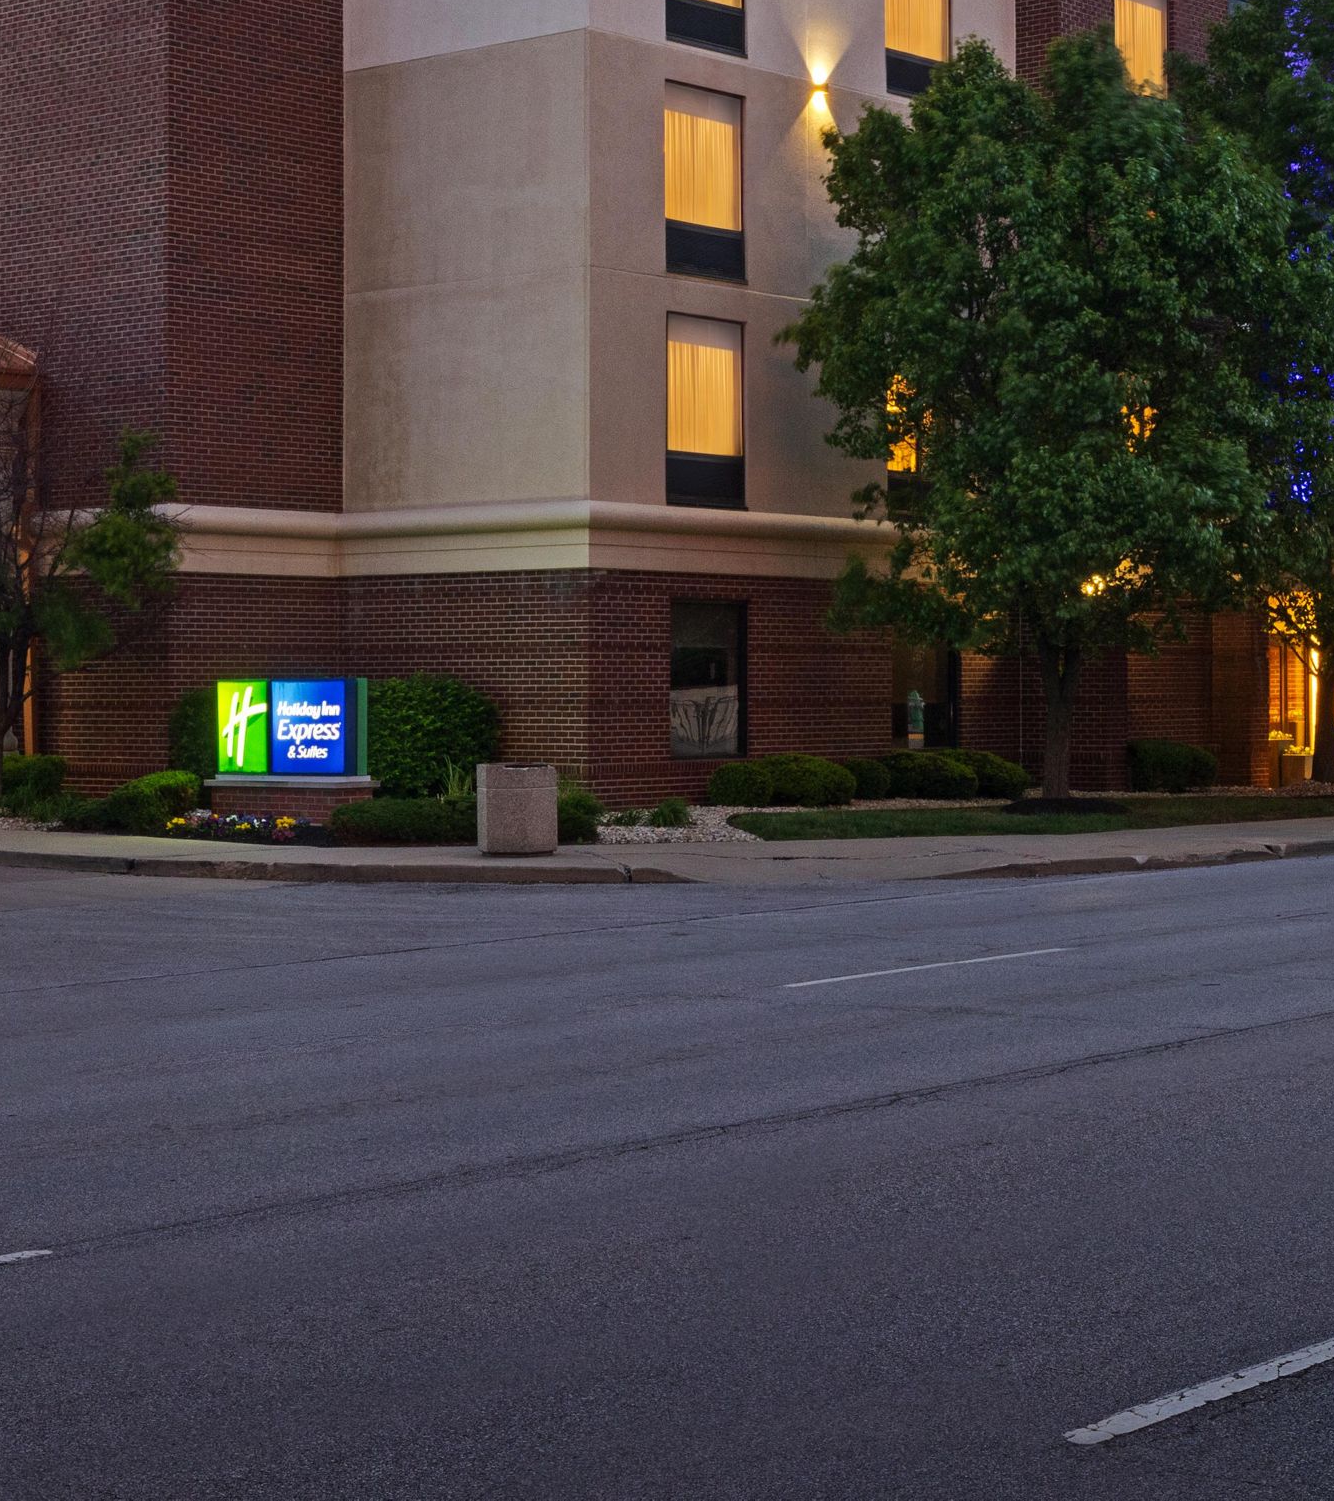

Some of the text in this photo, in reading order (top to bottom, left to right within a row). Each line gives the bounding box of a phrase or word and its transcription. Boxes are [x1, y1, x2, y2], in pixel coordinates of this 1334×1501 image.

[277, 700, 340, 719] Holiday Inn
[277, 719, 340, 745] Express
[287, 745, 328, 758] & Suites
